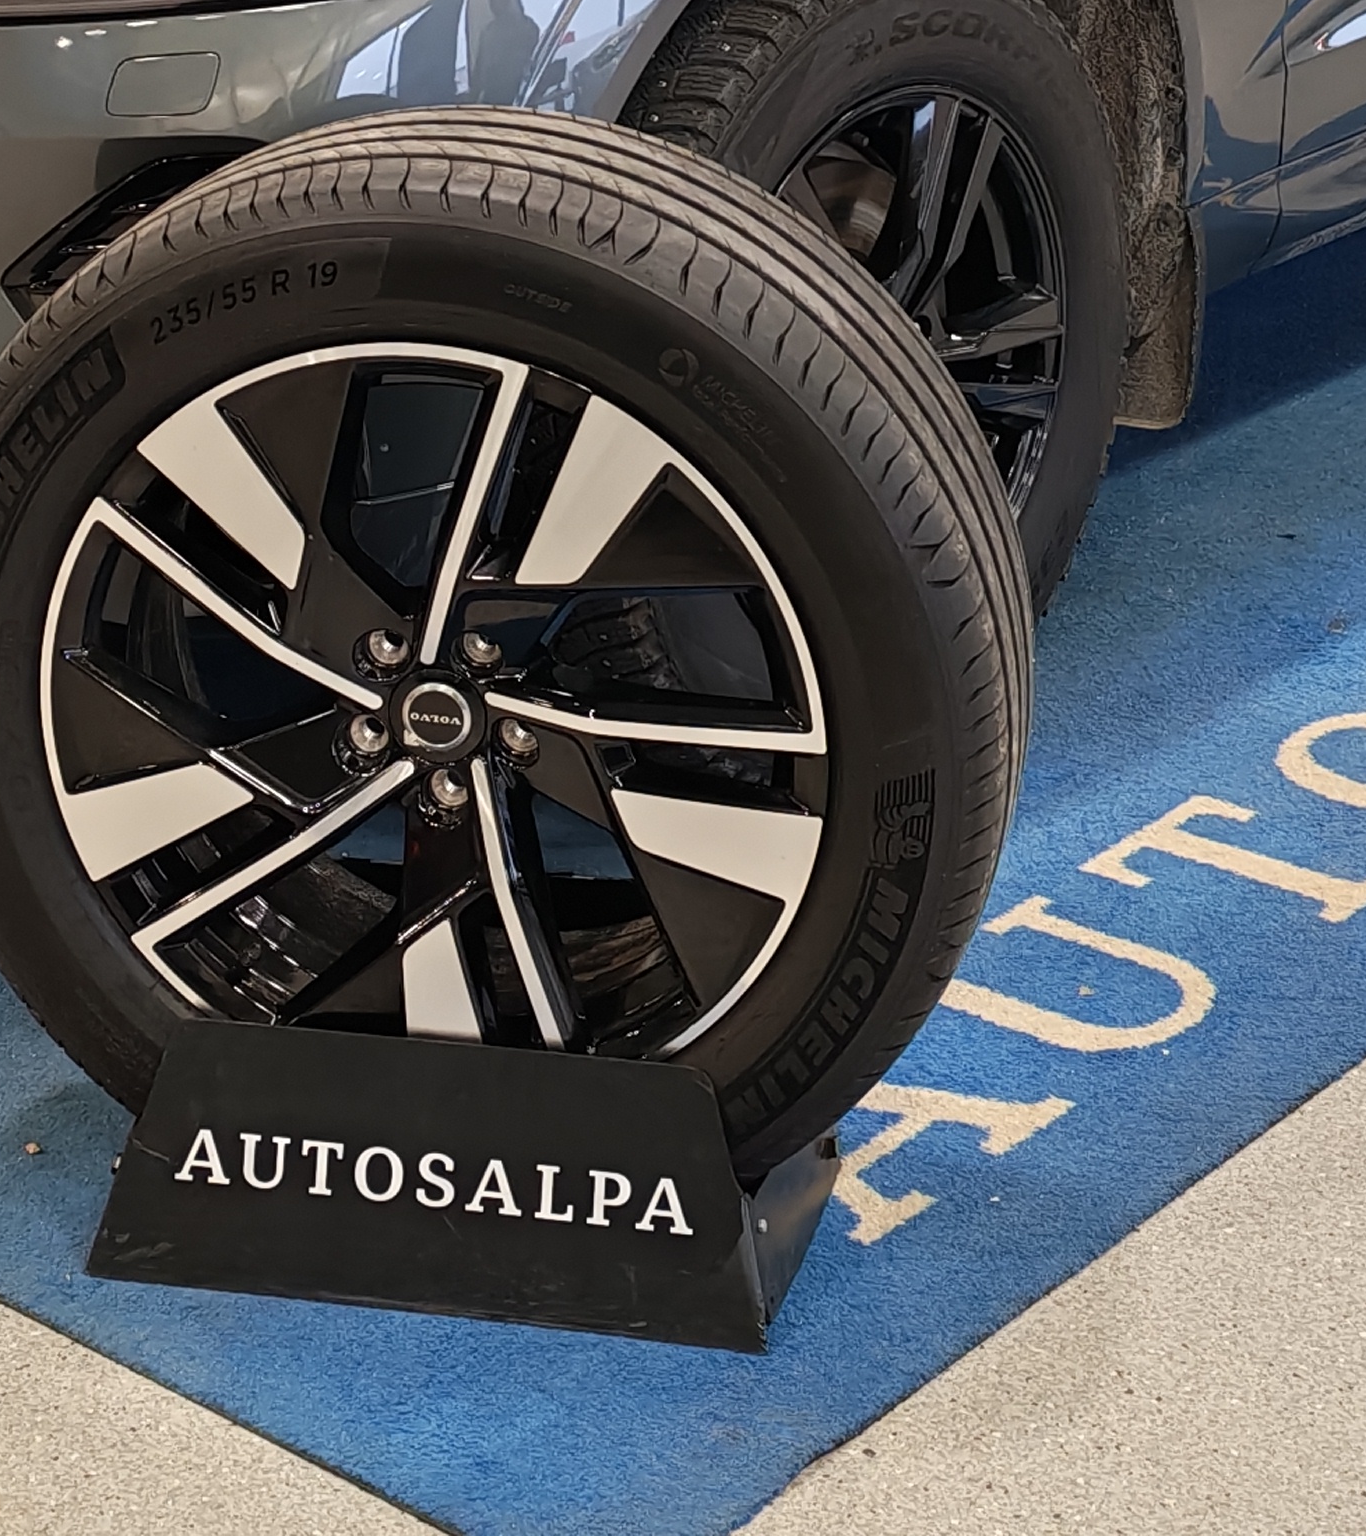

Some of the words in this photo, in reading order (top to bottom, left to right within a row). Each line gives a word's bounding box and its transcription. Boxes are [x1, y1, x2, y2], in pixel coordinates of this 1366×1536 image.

[149, 276, 257, 346] 235/55
[270, 268, 291, 297] R
[307, 260, 339, 289] 19
[410, 711, 462, 726] VOLVO
[728, 876, 910, 1128] MICHELIN
[174, 1127, 694, 1238] AUTOSALPA
